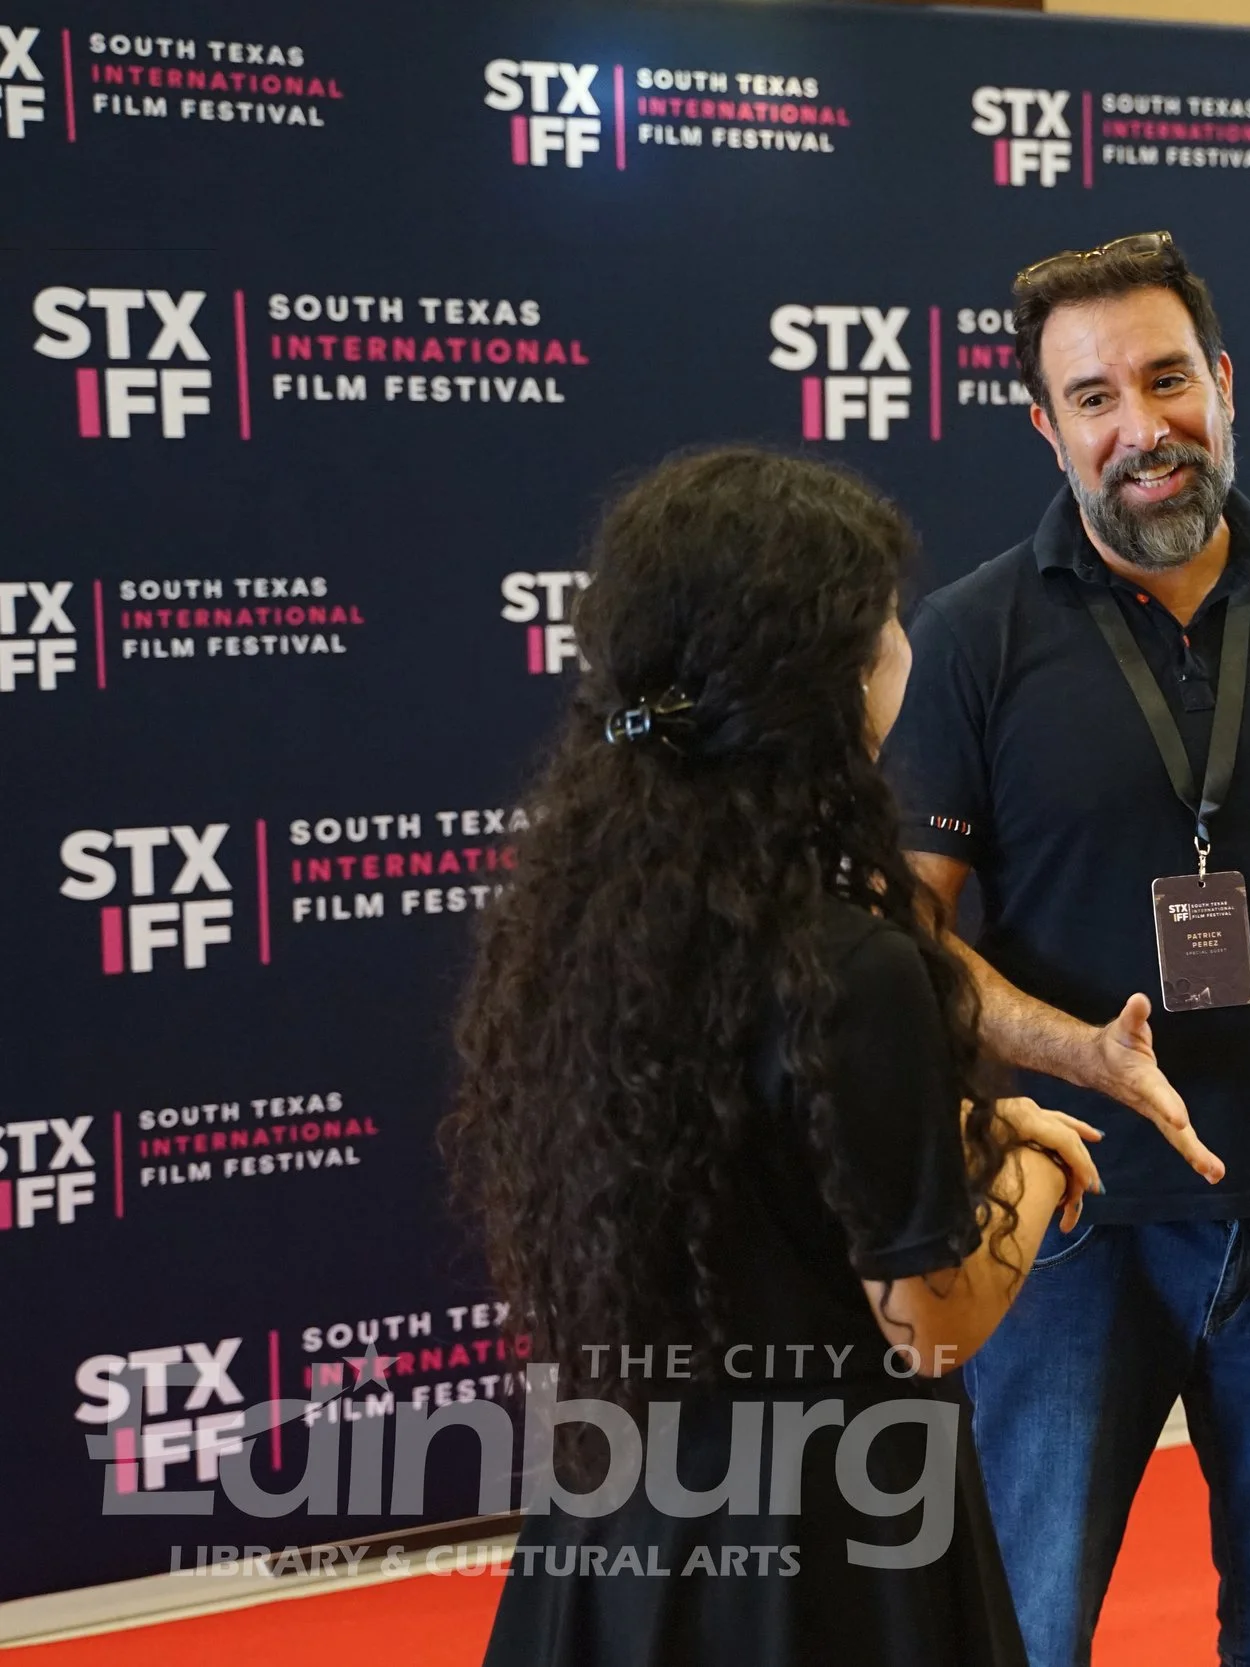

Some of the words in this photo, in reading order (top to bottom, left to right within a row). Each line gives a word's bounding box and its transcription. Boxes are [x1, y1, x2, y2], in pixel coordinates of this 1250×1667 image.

[89, 32, 195, 60] SOUTH
[208, 41, 305, 68] TEXAS
[91, 64, 344, 99] INTERNATIONAL
[484, 58, 600, 115] STX
[635, 67, 728, 93] SOUTH
[735, 73, 819, 99] TEXAS
[93, 93, 168, 118] FILM
[181, 99, 325, 127] FESTIVAL
[636, 96, 851, 127] INTERNATIONAL
[971, 86, 1071, 139] STX
[1101, 92, 1181, 115] SOUTH
[511, 115, 600, 168] IFF
[637, 122, 703, 146] FILM
[711, 127, 835, 153] FESTIVAL
[1102, 143, 1160, 165] FILM
[994, 139, 1072, 188] IFF
[33, 286, 211, 362] STX
[268, 293, 404, 323] SOUTH
[418, 297, 541, 327] TEXAS
[957, 308, 1019, 334] SOU
[271, 335, 590, 365] INTERNATIONAL
[769, 304, 911, 371] STX
[76, 367, 212, 439] IFF
[272, 373, 367, 401] FILM
[384, 376, 565, 404] FESTIVAL
[802, 376, 911, 441] IFF
[120, 579, 223, 601] SOUTH
[234, 576, 328, 598] TEXAS
[0, 582, 76, 635] TX
[121, 605, 365, 630] INTERNATIONAL
[0, 638, 77, 692] FF
[122, 637, 195, 659] FILM
[207, 634, 347, 657] FESTIVAL
[527, 623, 592, 675] IF
[290, 813, 421, 846] SOUTH
[59, 823, 233, 900] STX
[291, 846, 518, 884] INTERNATIO
[292, 892, 384, 923] FILM
[401, 884, 516, 916] FEST
[1168, 903, 1188, 914] STX
[1173, 912, 1188, 922] IFF
[1191, 906, 1235, 914] INTERNATIONAL
[101, 898, 234, 975] IFF
[1187, 931, 1222, 940] PATRICK
[1192, 940, 1219, 948] PEREZ
[139, 1102, 240, 1131] SOUTH
[251, 1091, 343, 1118] TEXAS
[0, 1115, 95, 1174] TX
[140, 1116, 380, 1159] INTERNATIONAL
[140, 1161, 211, 1187] FILM
[223, 1145, 361, 1177] FESTIVAL
[302, 1311, 432, 1352] SOUTH
[447, 1302, 510, 1332] TEX
[303, 1333, 531, 1389] INTERNATIO
[74, 1337, 245, 1424] STX
[303, 1391, 395, 1428] FILM
[115, 1411, 246, 1494] IFF
